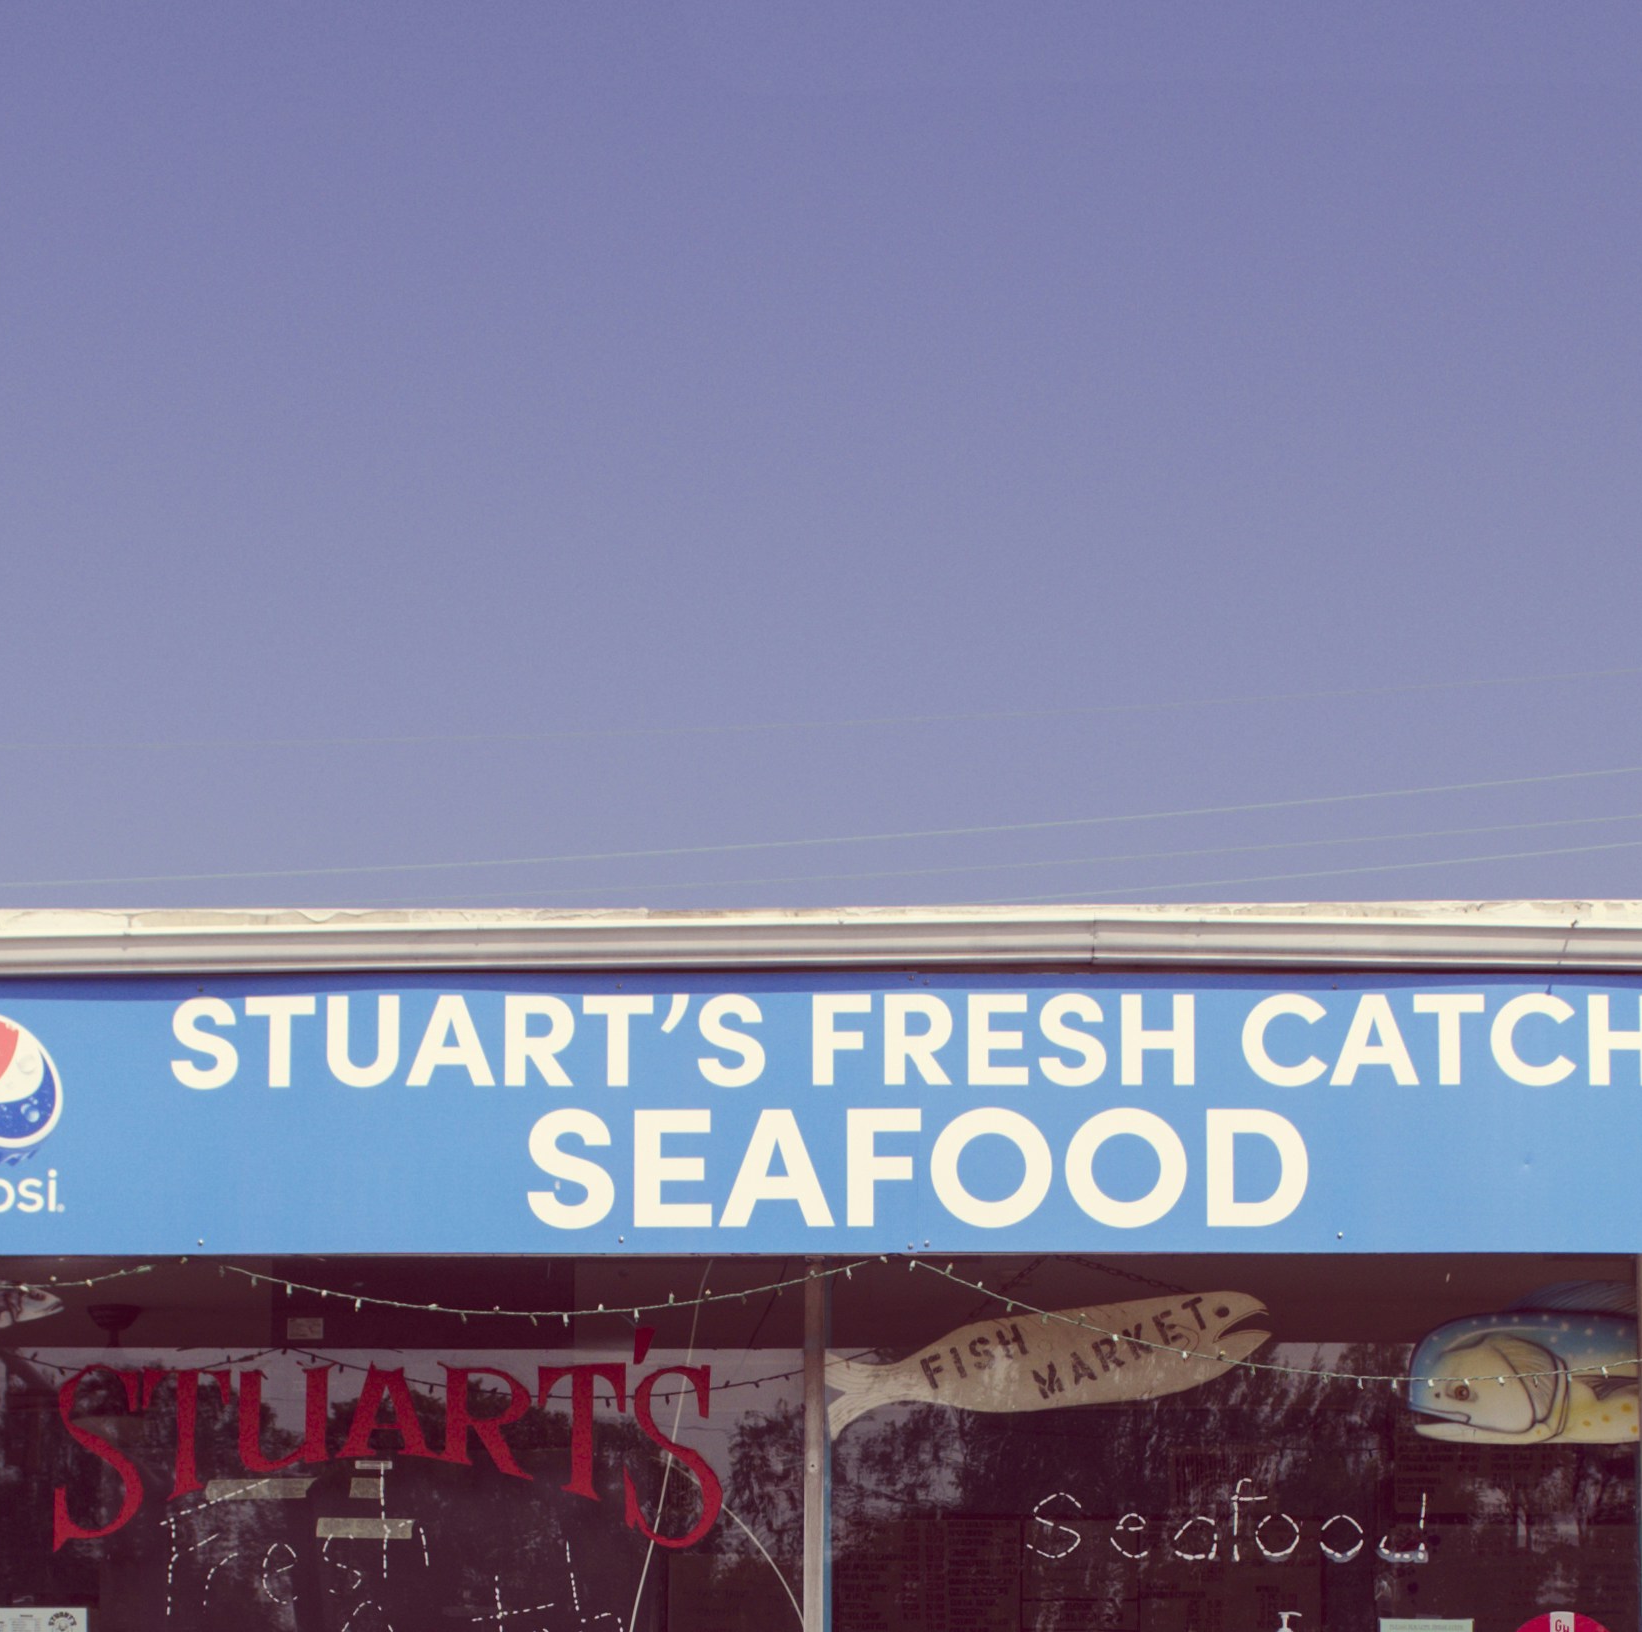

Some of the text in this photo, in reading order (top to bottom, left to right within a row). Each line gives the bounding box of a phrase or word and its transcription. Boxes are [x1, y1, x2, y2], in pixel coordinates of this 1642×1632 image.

[168, 991, 768, 1091] STUART'S
[810, 990, 1197, 1088] FRESH
[525, 1105, 1311, 1231] SEAFOOD
[919, 1323, 1030, 1391] FISH
[1031, 1296, 1209, 1401] MARKET
[53, 1327, 723, 1552] STUART'S
[1026, 1478, 1428, 1563] Seafood
